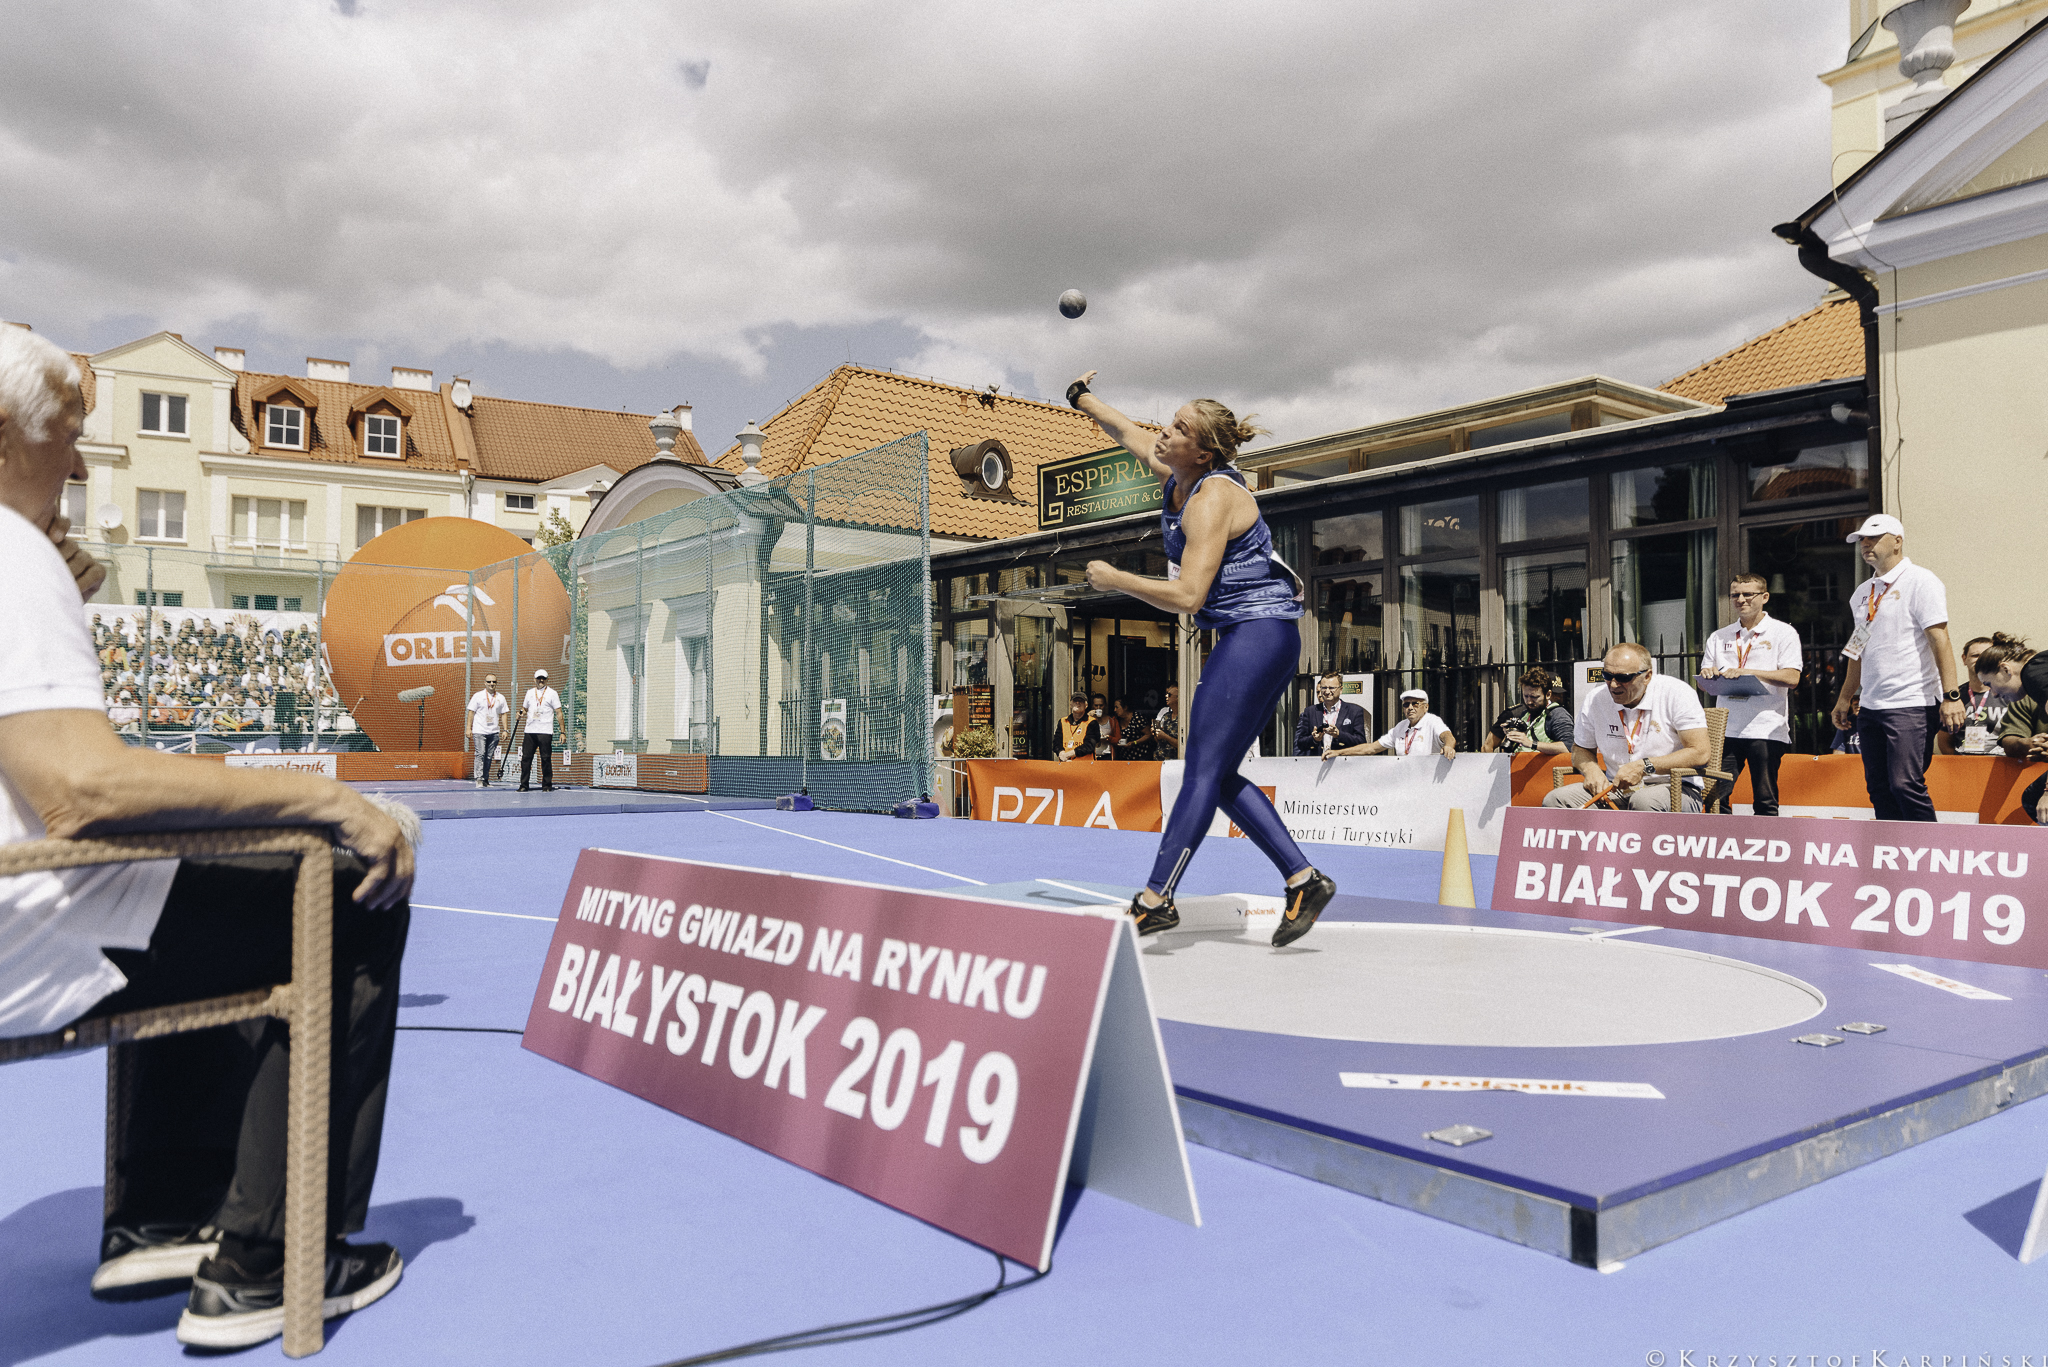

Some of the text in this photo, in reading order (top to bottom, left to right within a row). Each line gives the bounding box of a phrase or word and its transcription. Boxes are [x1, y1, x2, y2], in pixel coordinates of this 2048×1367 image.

[1066, 493, 1139, 517] RESTAURANT
[1141, 492, 1151, 503] &
[390, 635, 493, 661] ORLEN
[1283, 800, 1379, 816] Ministerstwo
[1285, 826, 1413, 847] portu i Turystyki
[1522, 827, 2029, 878] MITYNG GWIAZD NA RYNKU
[1514, 860, 2026, 945] BIAŁYSTOK 2019
[575, 886, 1048, 1020] MITYNG GWIAZD NA RYNKU
[548, 943, 1019, 1165] BIAŁYSTOK 2019
